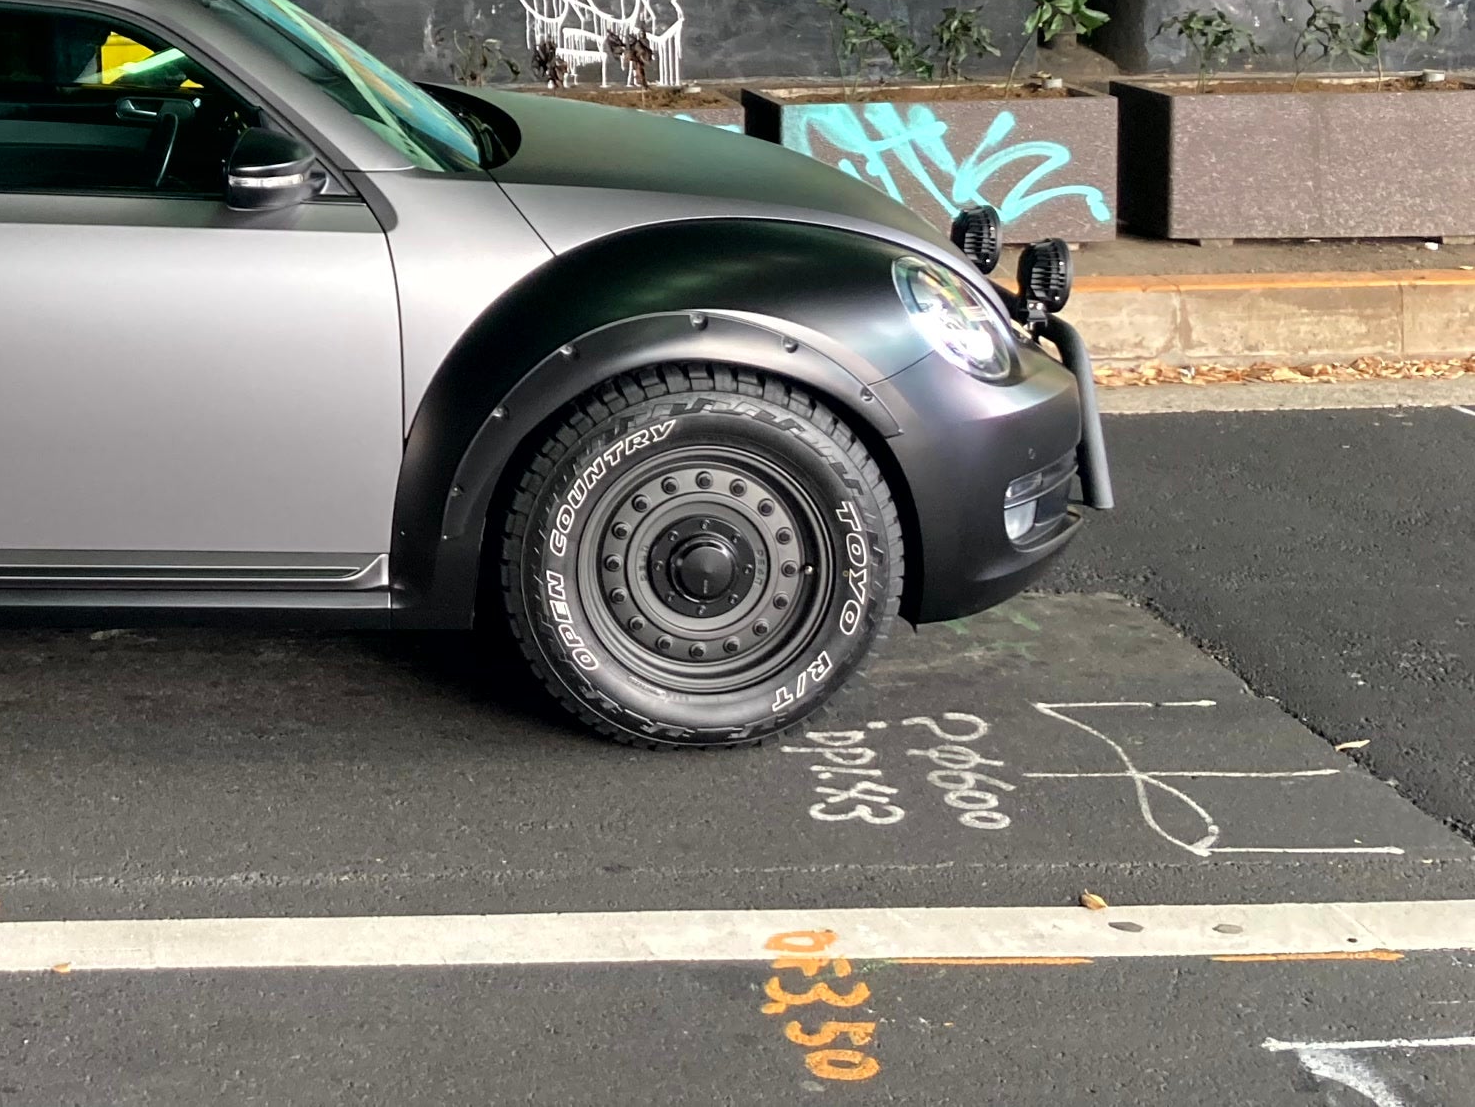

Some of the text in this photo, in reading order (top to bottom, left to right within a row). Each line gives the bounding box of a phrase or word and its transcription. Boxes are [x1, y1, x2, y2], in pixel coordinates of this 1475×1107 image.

[545, 418, 677, 672] OPEN COUNTRY
[771, 501, 870, 713] TOYO R/T
